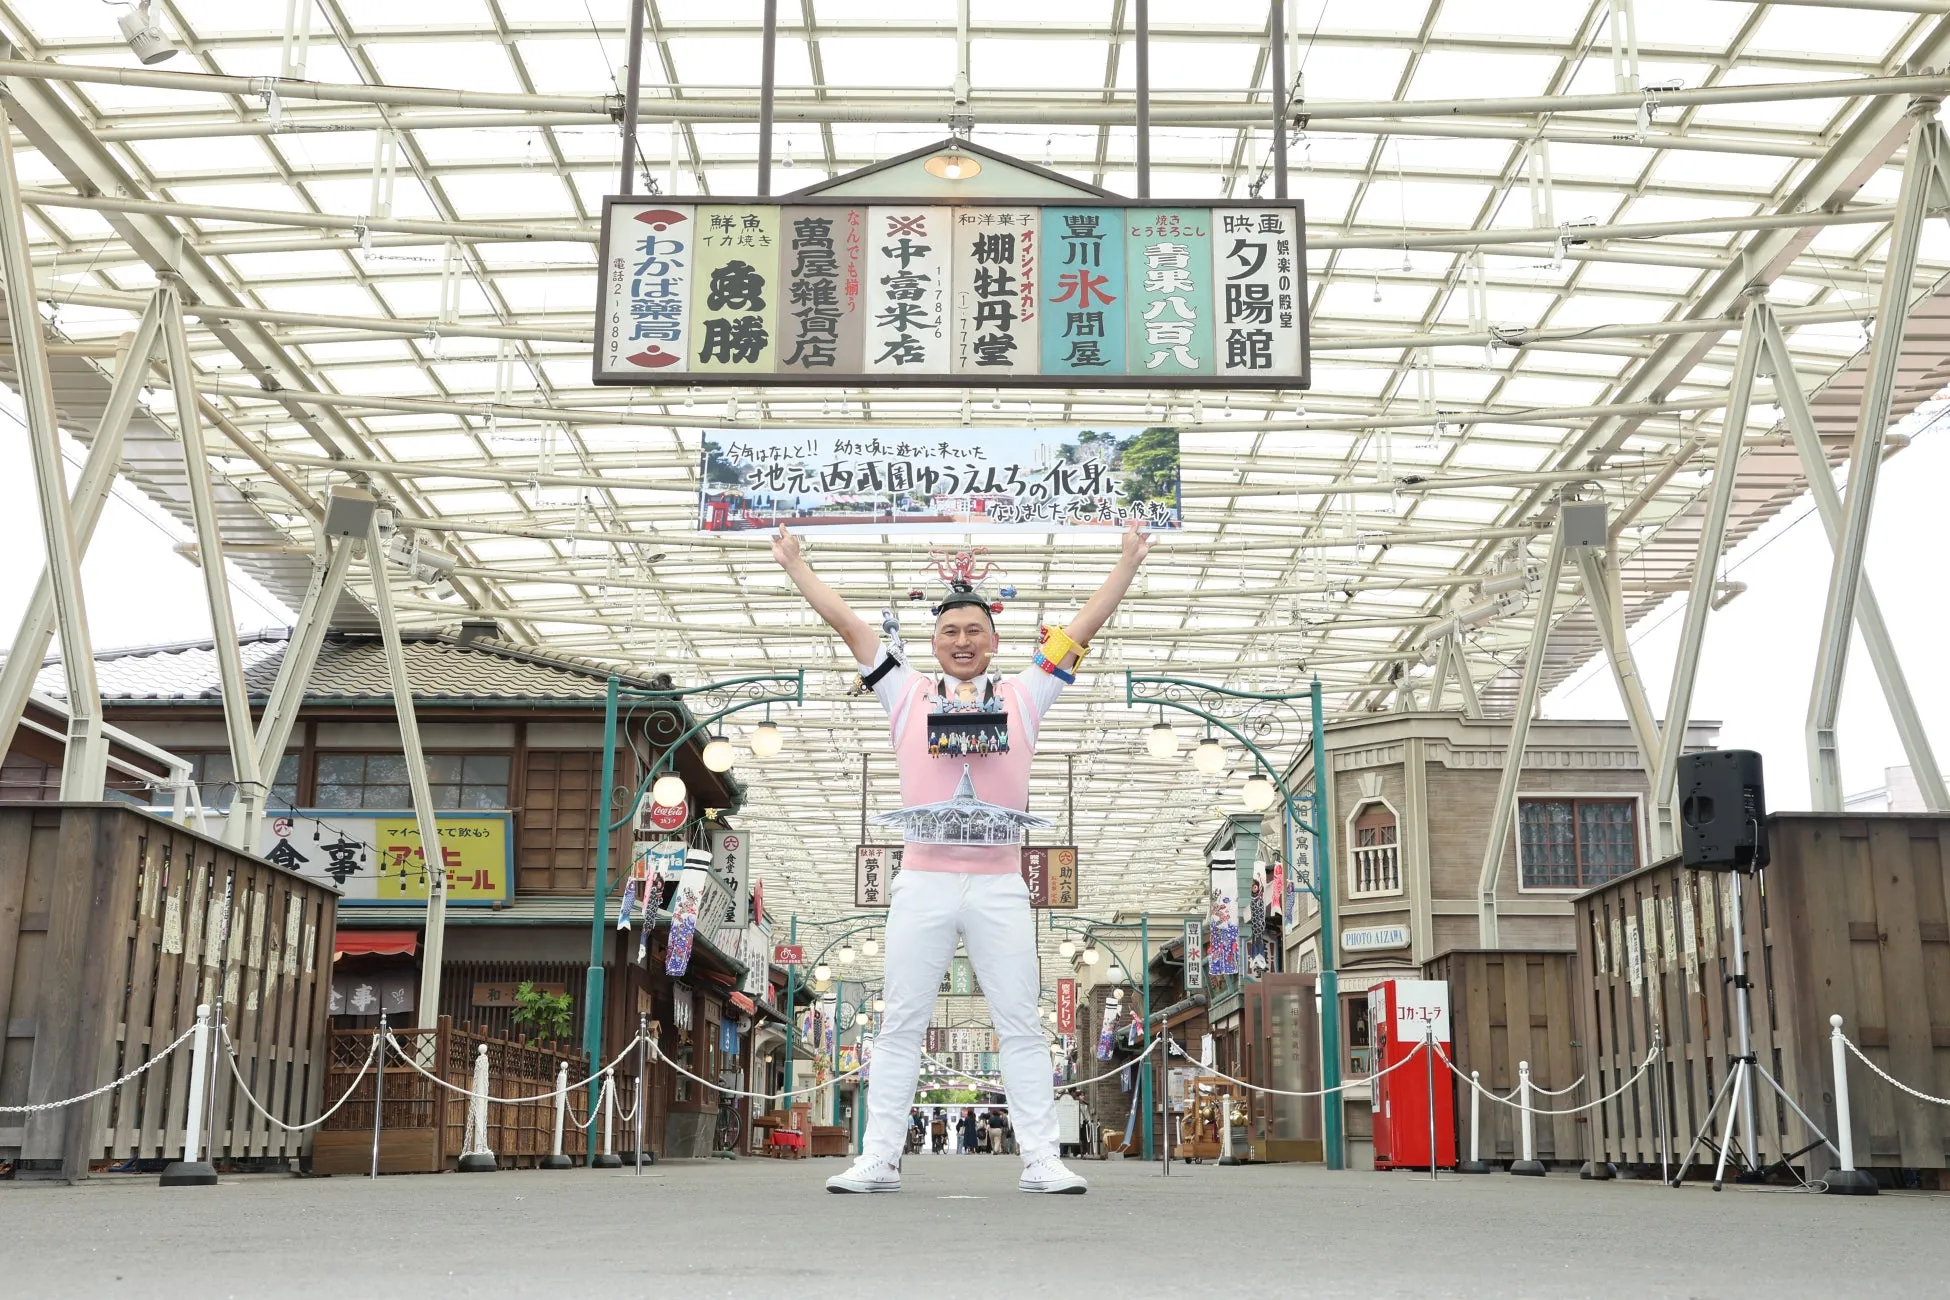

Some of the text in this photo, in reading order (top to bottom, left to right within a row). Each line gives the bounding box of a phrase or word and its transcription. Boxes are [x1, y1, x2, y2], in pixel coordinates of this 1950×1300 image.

[710, 213, 765, 234] 鮮魚
[958, 213, 1034, 226] 和洋菓子
[1131, 227, 1206, 237] とうもろこし
[1155, 215, 1180, 226] 焼き
[1224, 213, 1285, 235] 映画
[703, 235, 772, 247] イカ焼き
[844, 210, 860, 313] なんでも揃う
[1020, 230, 1034, 323] オイシイオカシ
[1276, 240, 1292, 329] 娯楽の殿堂
[698, 260, 769, 364] 魚勝
[970, 232, 1019, 366] 棚牡丹堂
[1141, 242, 1201, 369] 青果八百八
[1226, 238, 1275, 370] 夕陽館
[834, 438, 987, 460] 幼き頃に遊びに来ていた
[748, 457, 1127, 499] 地元、西武園ゆうえんちの化身に
[725, 853, 737, 874] 食堂
[864, 858, 879, 903] 夢見堂
[1060, 866, 1072, 903] 助六屋
[1345, 928, 1404, 946] PHOTO AIZAWA
[1397, 1007, 1442, 1020] コカ・コーラ
